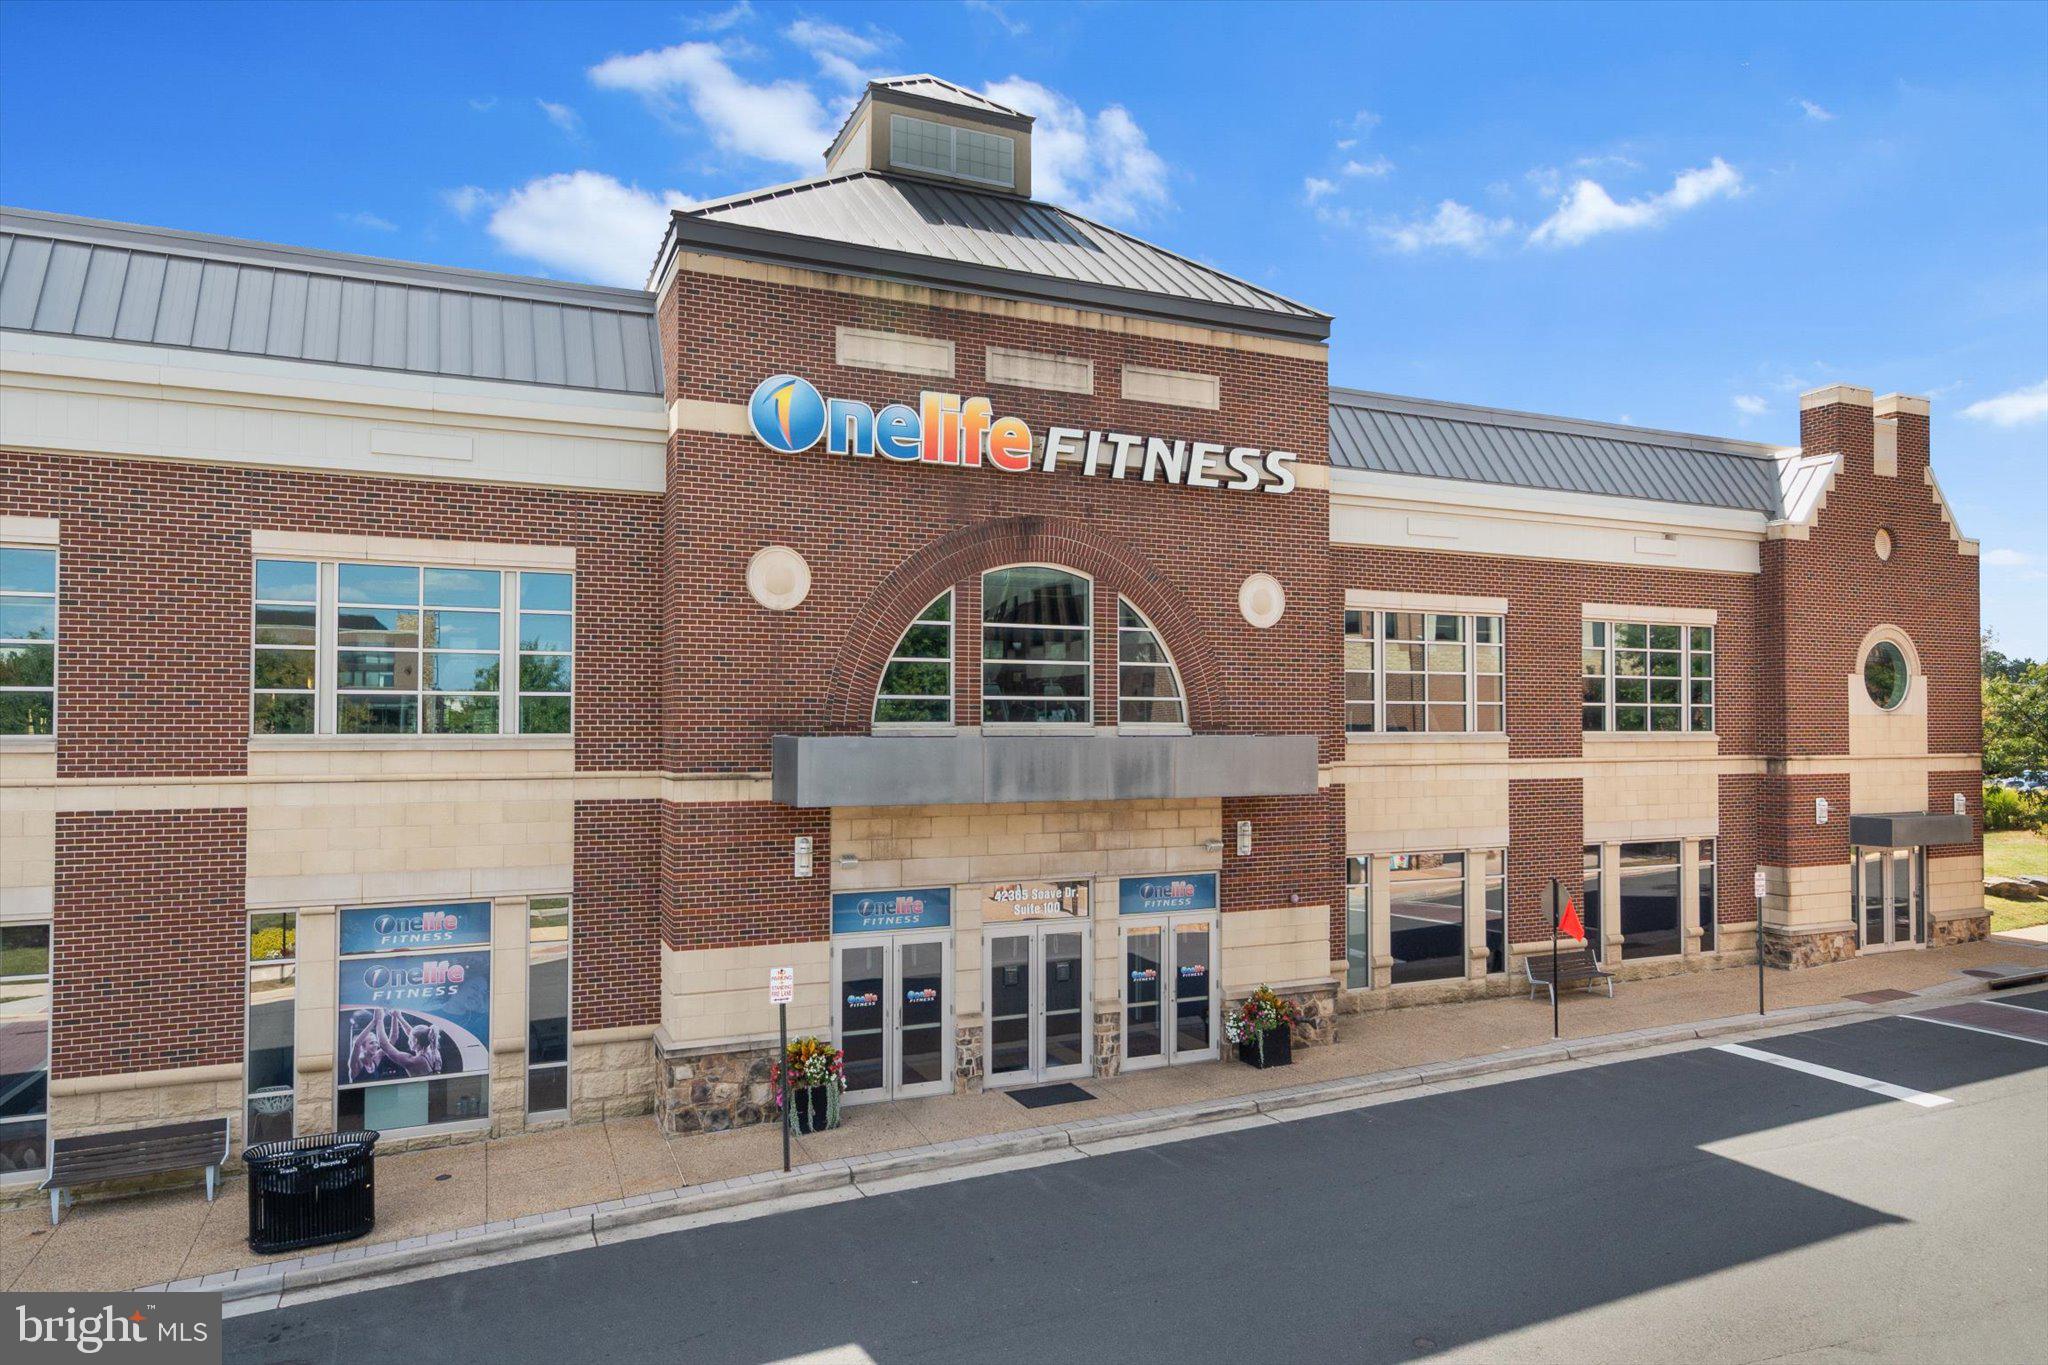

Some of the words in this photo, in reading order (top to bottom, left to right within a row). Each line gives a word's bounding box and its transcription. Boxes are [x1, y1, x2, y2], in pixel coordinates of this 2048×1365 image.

[748, 372, 1032, 472] Onelife
[1043, 426, 1297, 494] FITNESS
[1065, 886, 1079, 898] Dr.
[1140, 880, 1195, 900] Onelife
[857, 896, 924, 917] Onelife
[1014, 903, 1041, 916] Suite
[1044, 901, 1061, 914] 100
[1144, 897, 1192, 908] FITNESS
[374, 911, 458, 935] Onelife
[863, 915, 920, 926] FITNESS
[381, 932, 453, 945] FITNESS
[364, 960, 465, 989] Onelife
[372, 985, 459, 1001] FITNESS
[280, 1166, 298, 1174] Trash
